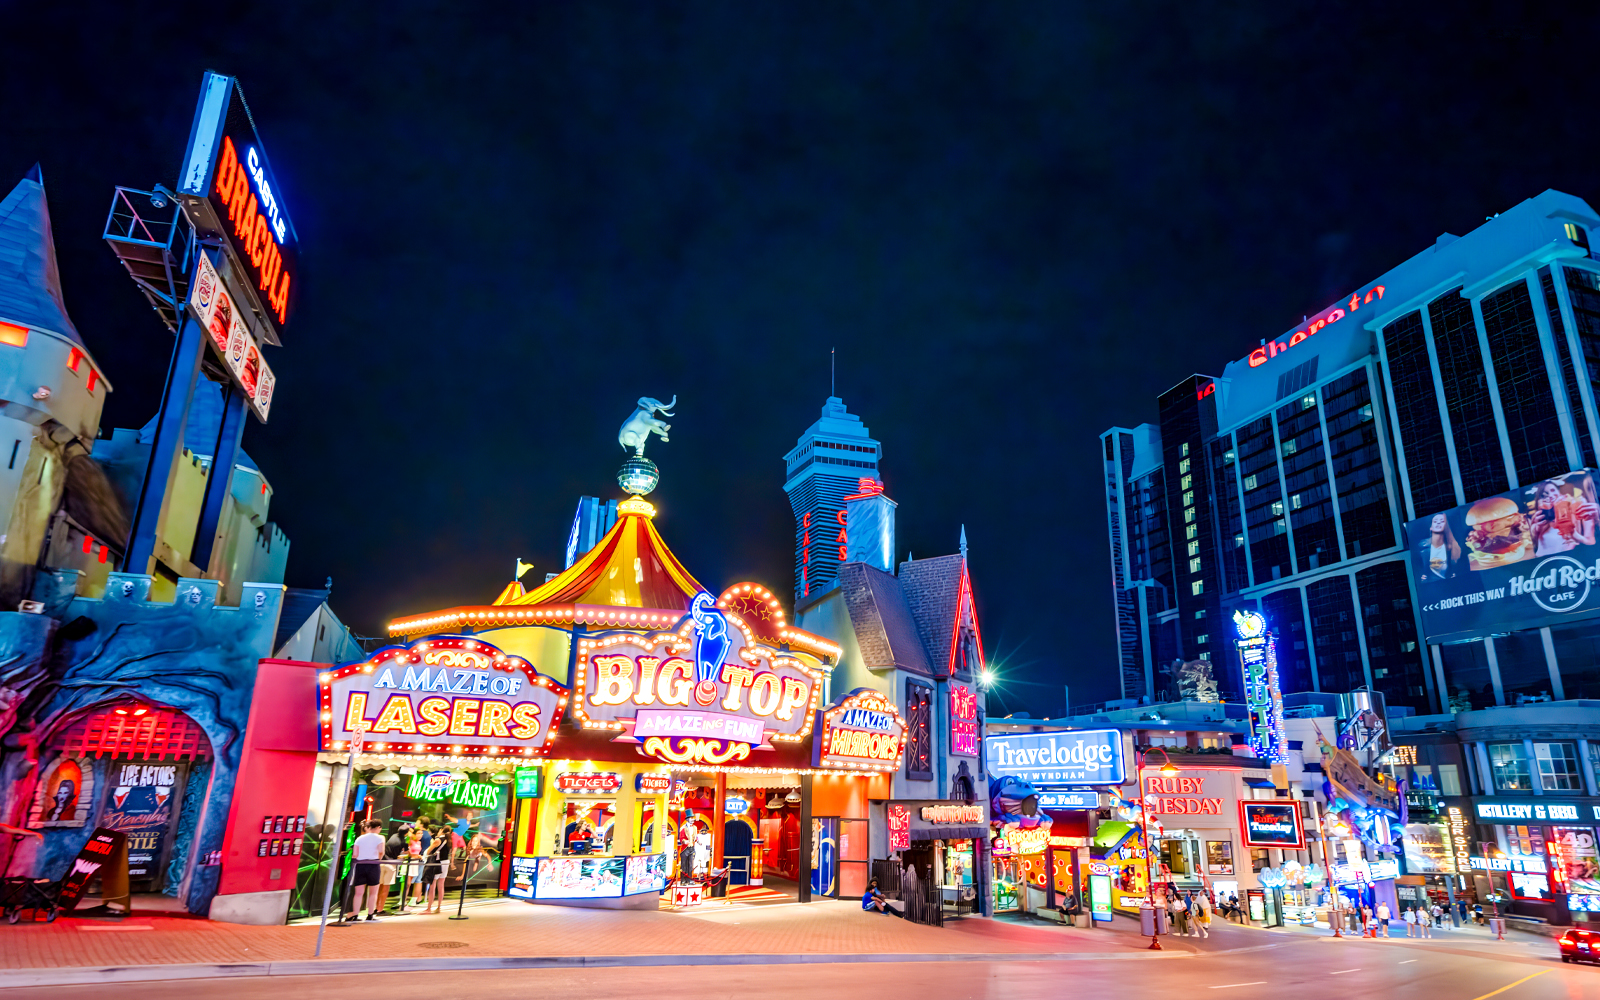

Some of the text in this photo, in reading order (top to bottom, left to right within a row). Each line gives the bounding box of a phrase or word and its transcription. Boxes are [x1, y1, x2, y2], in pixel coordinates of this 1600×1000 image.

[247, 147, 287, 245] CASTLE
[215, 136, 290, 325] DRACULA
[1509, 568, 1557, 597] Hard
[1440, 587, 1505, 611] ROCK THIS WAY
[1549, 591, 1576, 604] CAFE
[399, 666, 489, 696] MAZE
[489, 677, 522, 697] OF
[589, 655, 812, 721] BIG TOP
[342, 690, 542, 740] LASERS
[1248, 665, 1271, 749] PUTT
[992, 739, 1113, 772] Travelodge
[120, 765, 176, 787] LIVE ACTORS
[564, 778, 615, 788] TICKETS
[645, 778, 669, 788] TICKETS
[1032, 771, 1085, 780] WYNDHAM
[1147, 777, 1206, 795] RUBY
[452, 779, 501, 811] LASERS
[1058, 795, 1084, 805] Falls
[1252, 814, 1279, 825] Ruby
[1534, 805, 1547, 819] &
[1547, 805, 1579, 819] BBQ
[1251, 822, 1293, 834] Tuesday
[1454, 836, 1472, 873] STORE
